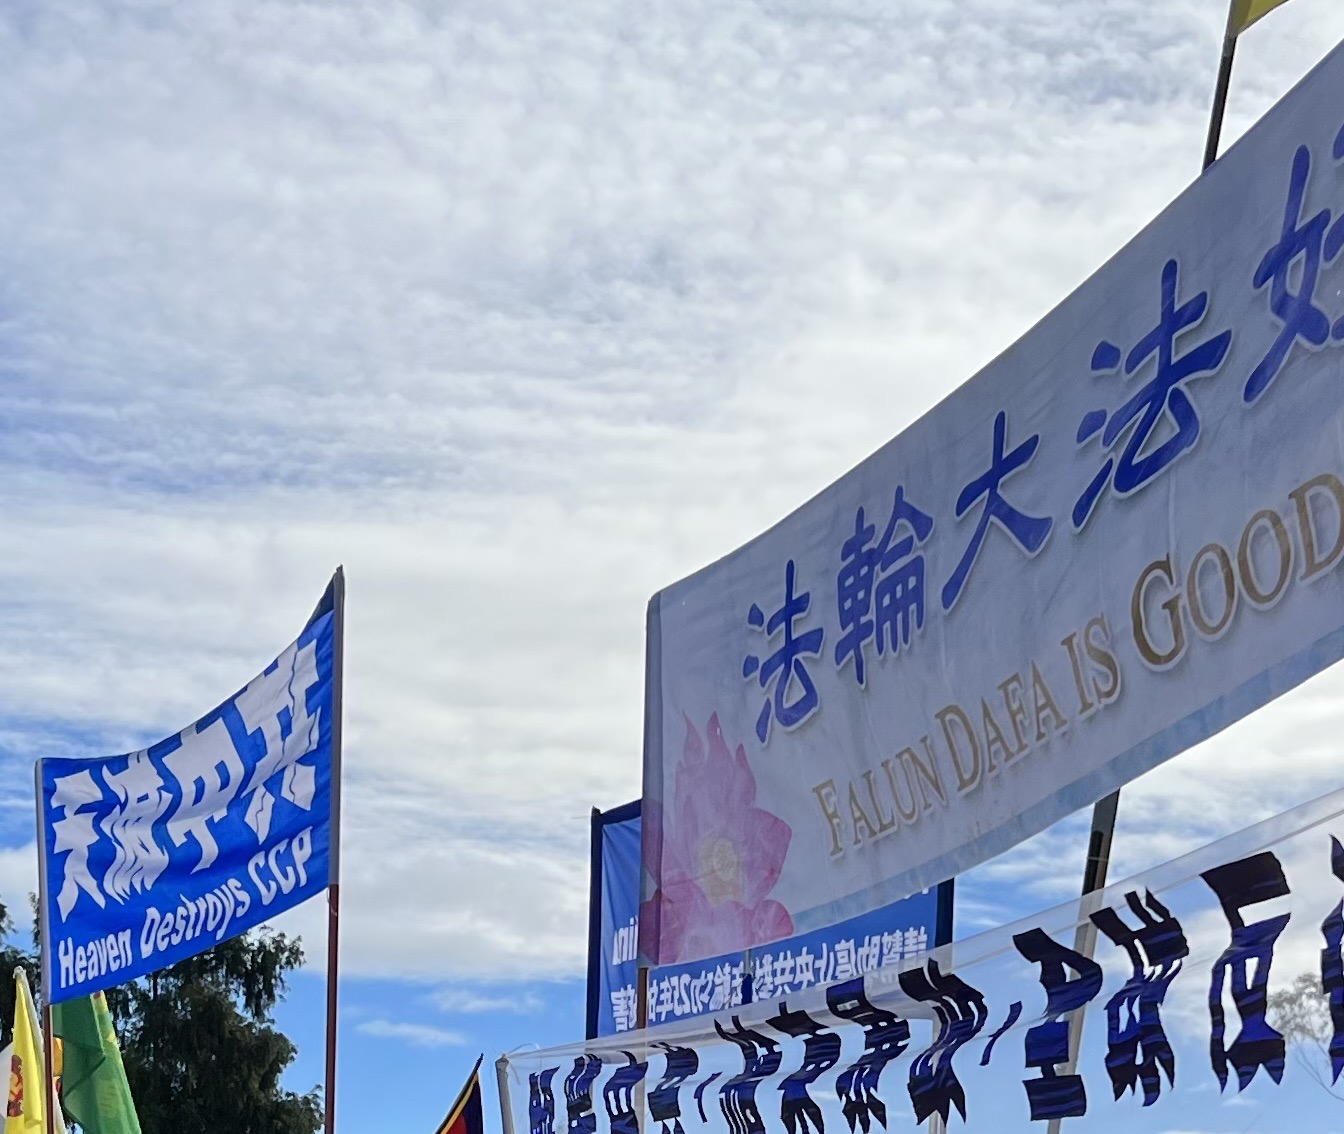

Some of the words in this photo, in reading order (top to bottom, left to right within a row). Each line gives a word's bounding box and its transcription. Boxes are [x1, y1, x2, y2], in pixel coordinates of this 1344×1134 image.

[50, 639, 321, 923] 天滅中共
[812, 736, 947, 856] FALUN
[935, 659, 1067, 795] DAFA
[1060, 612, 1121, 714] IS
[58, 927, 132, 989] Heaven
[140, 877, 251, 959] Destroys
[248, 825, 313, 907] CCP
